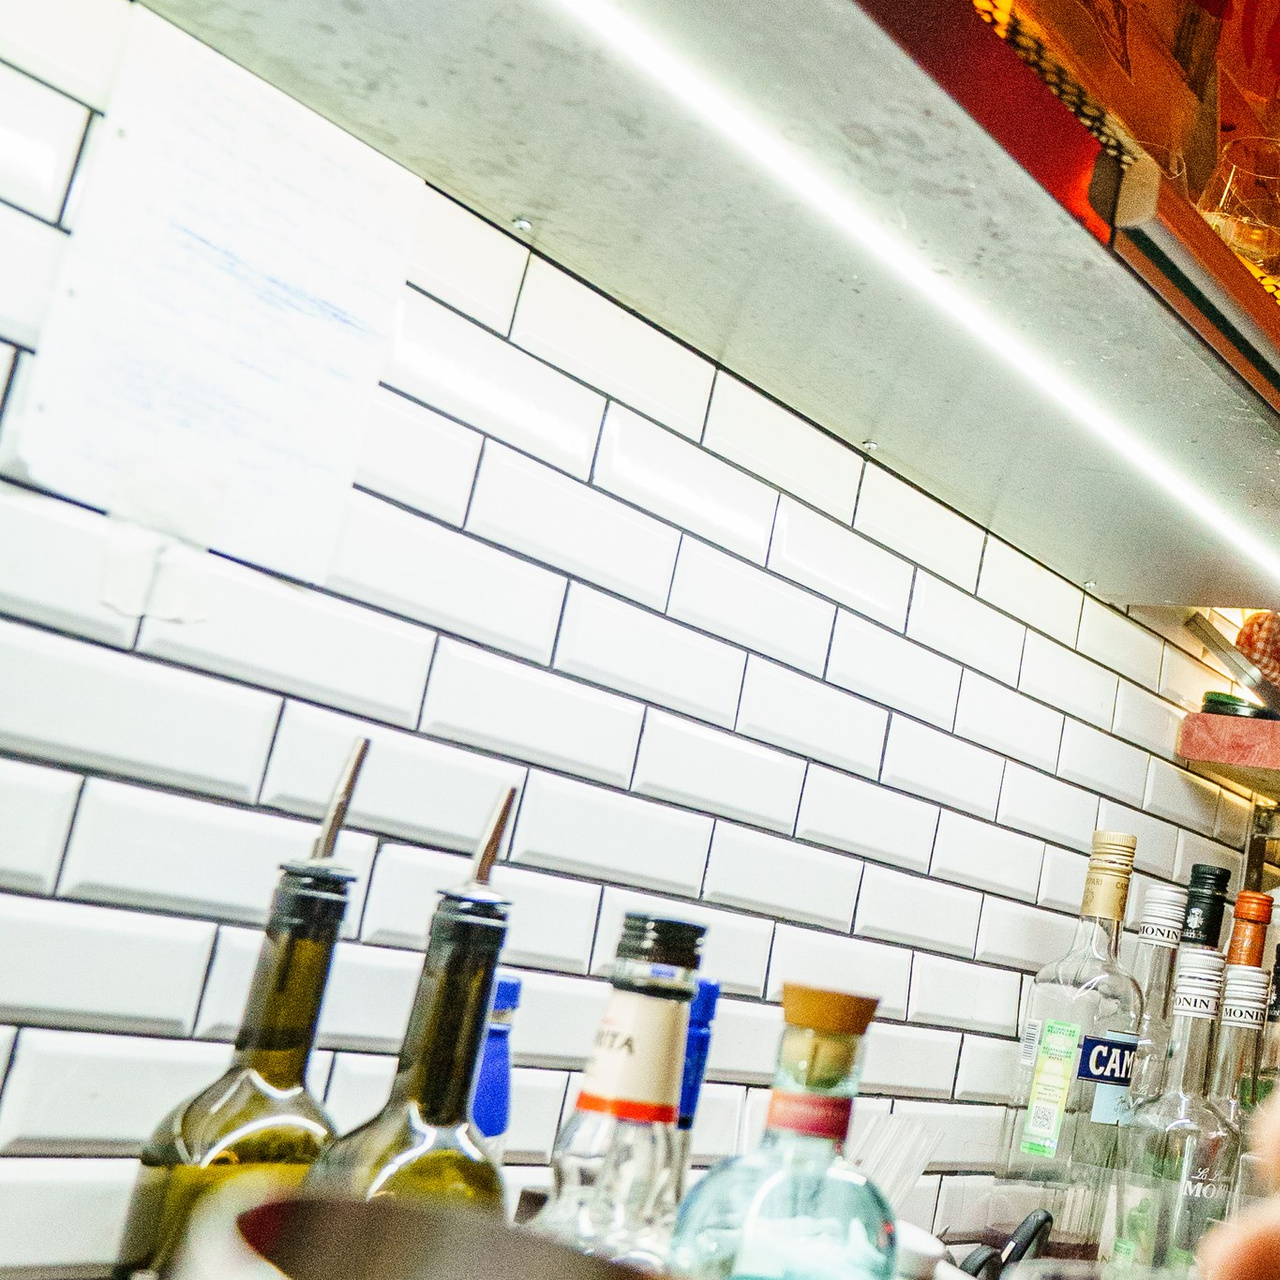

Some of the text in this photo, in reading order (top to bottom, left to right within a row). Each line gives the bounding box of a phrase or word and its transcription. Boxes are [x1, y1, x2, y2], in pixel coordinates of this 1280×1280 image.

[1175, 996, 1212, 1010] ONIN
[1223, 1007, 1266, 1021] MONIN
[1088, 1044, 1137, 1079] CAM
